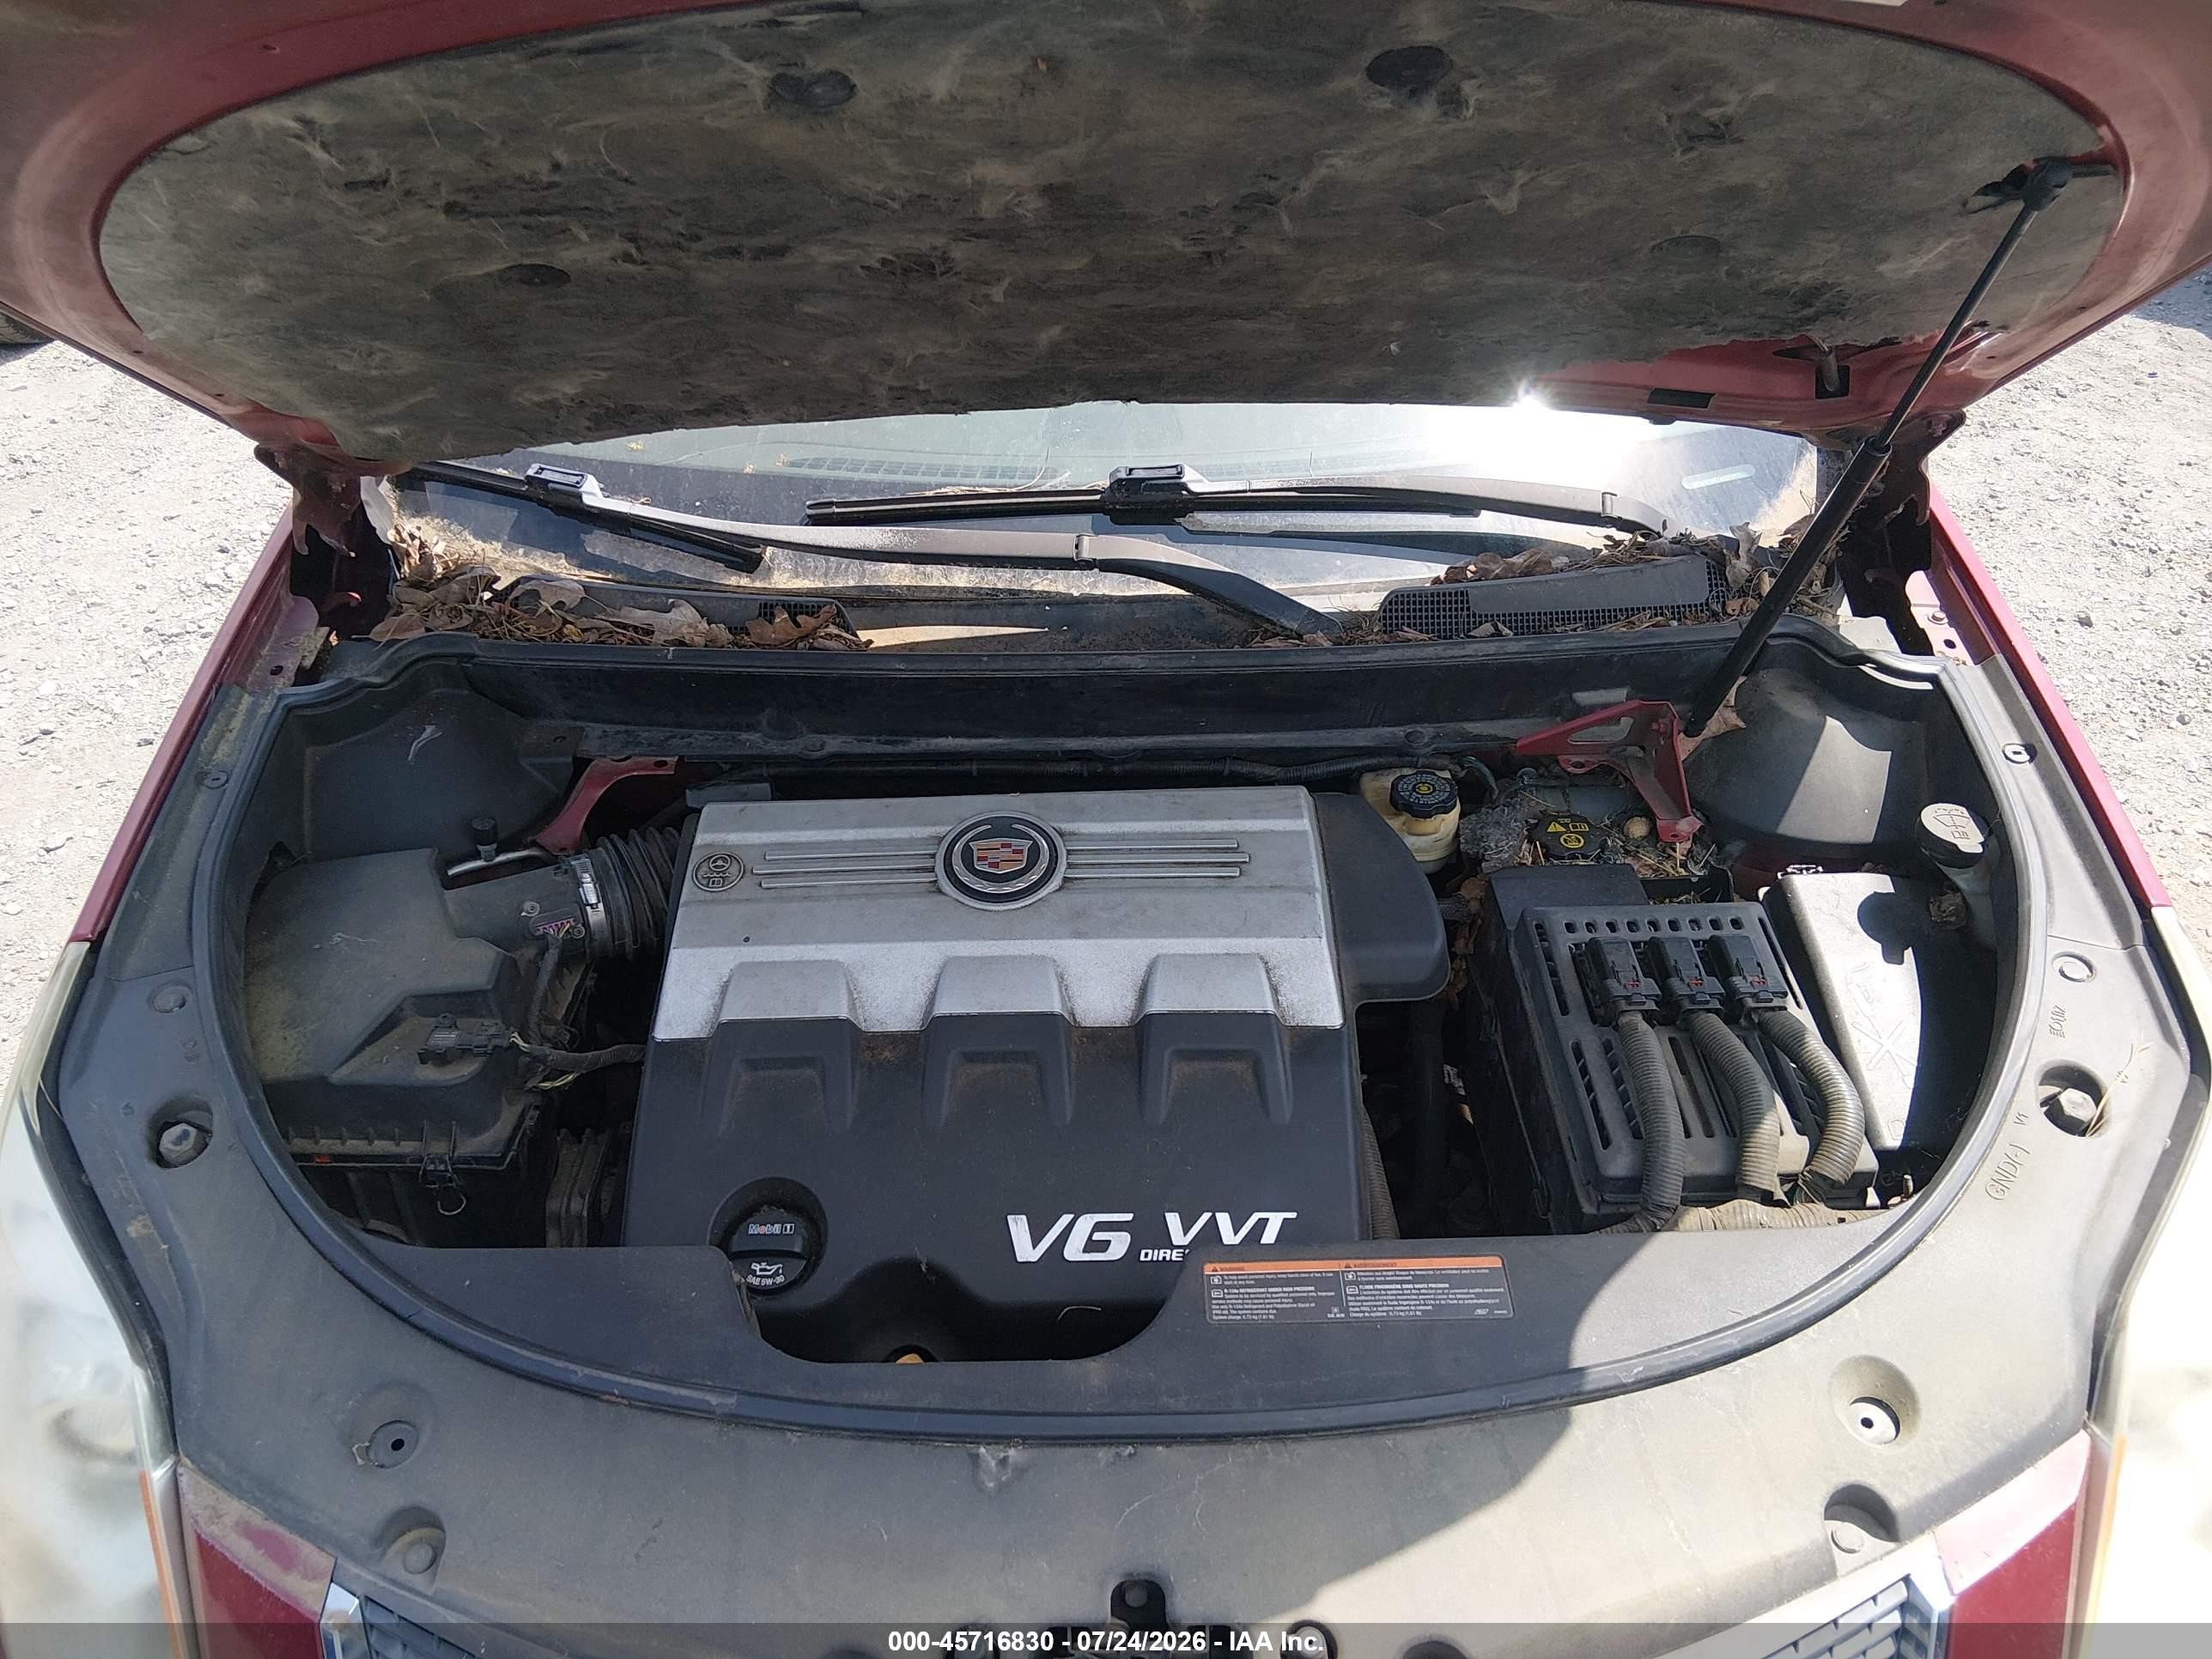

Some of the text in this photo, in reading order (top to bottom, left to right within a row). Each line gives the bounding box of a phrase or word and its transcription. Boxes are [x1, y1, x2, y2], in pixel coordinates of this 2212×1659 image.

[748, 1223, 781, 1235] Mobil
[1006, 1212, 1297, 1262] V6 VVT
[1139, 1249, 1190, 1262] DIRE
[746, 1274, 785, 1286] SAE 5W-30
